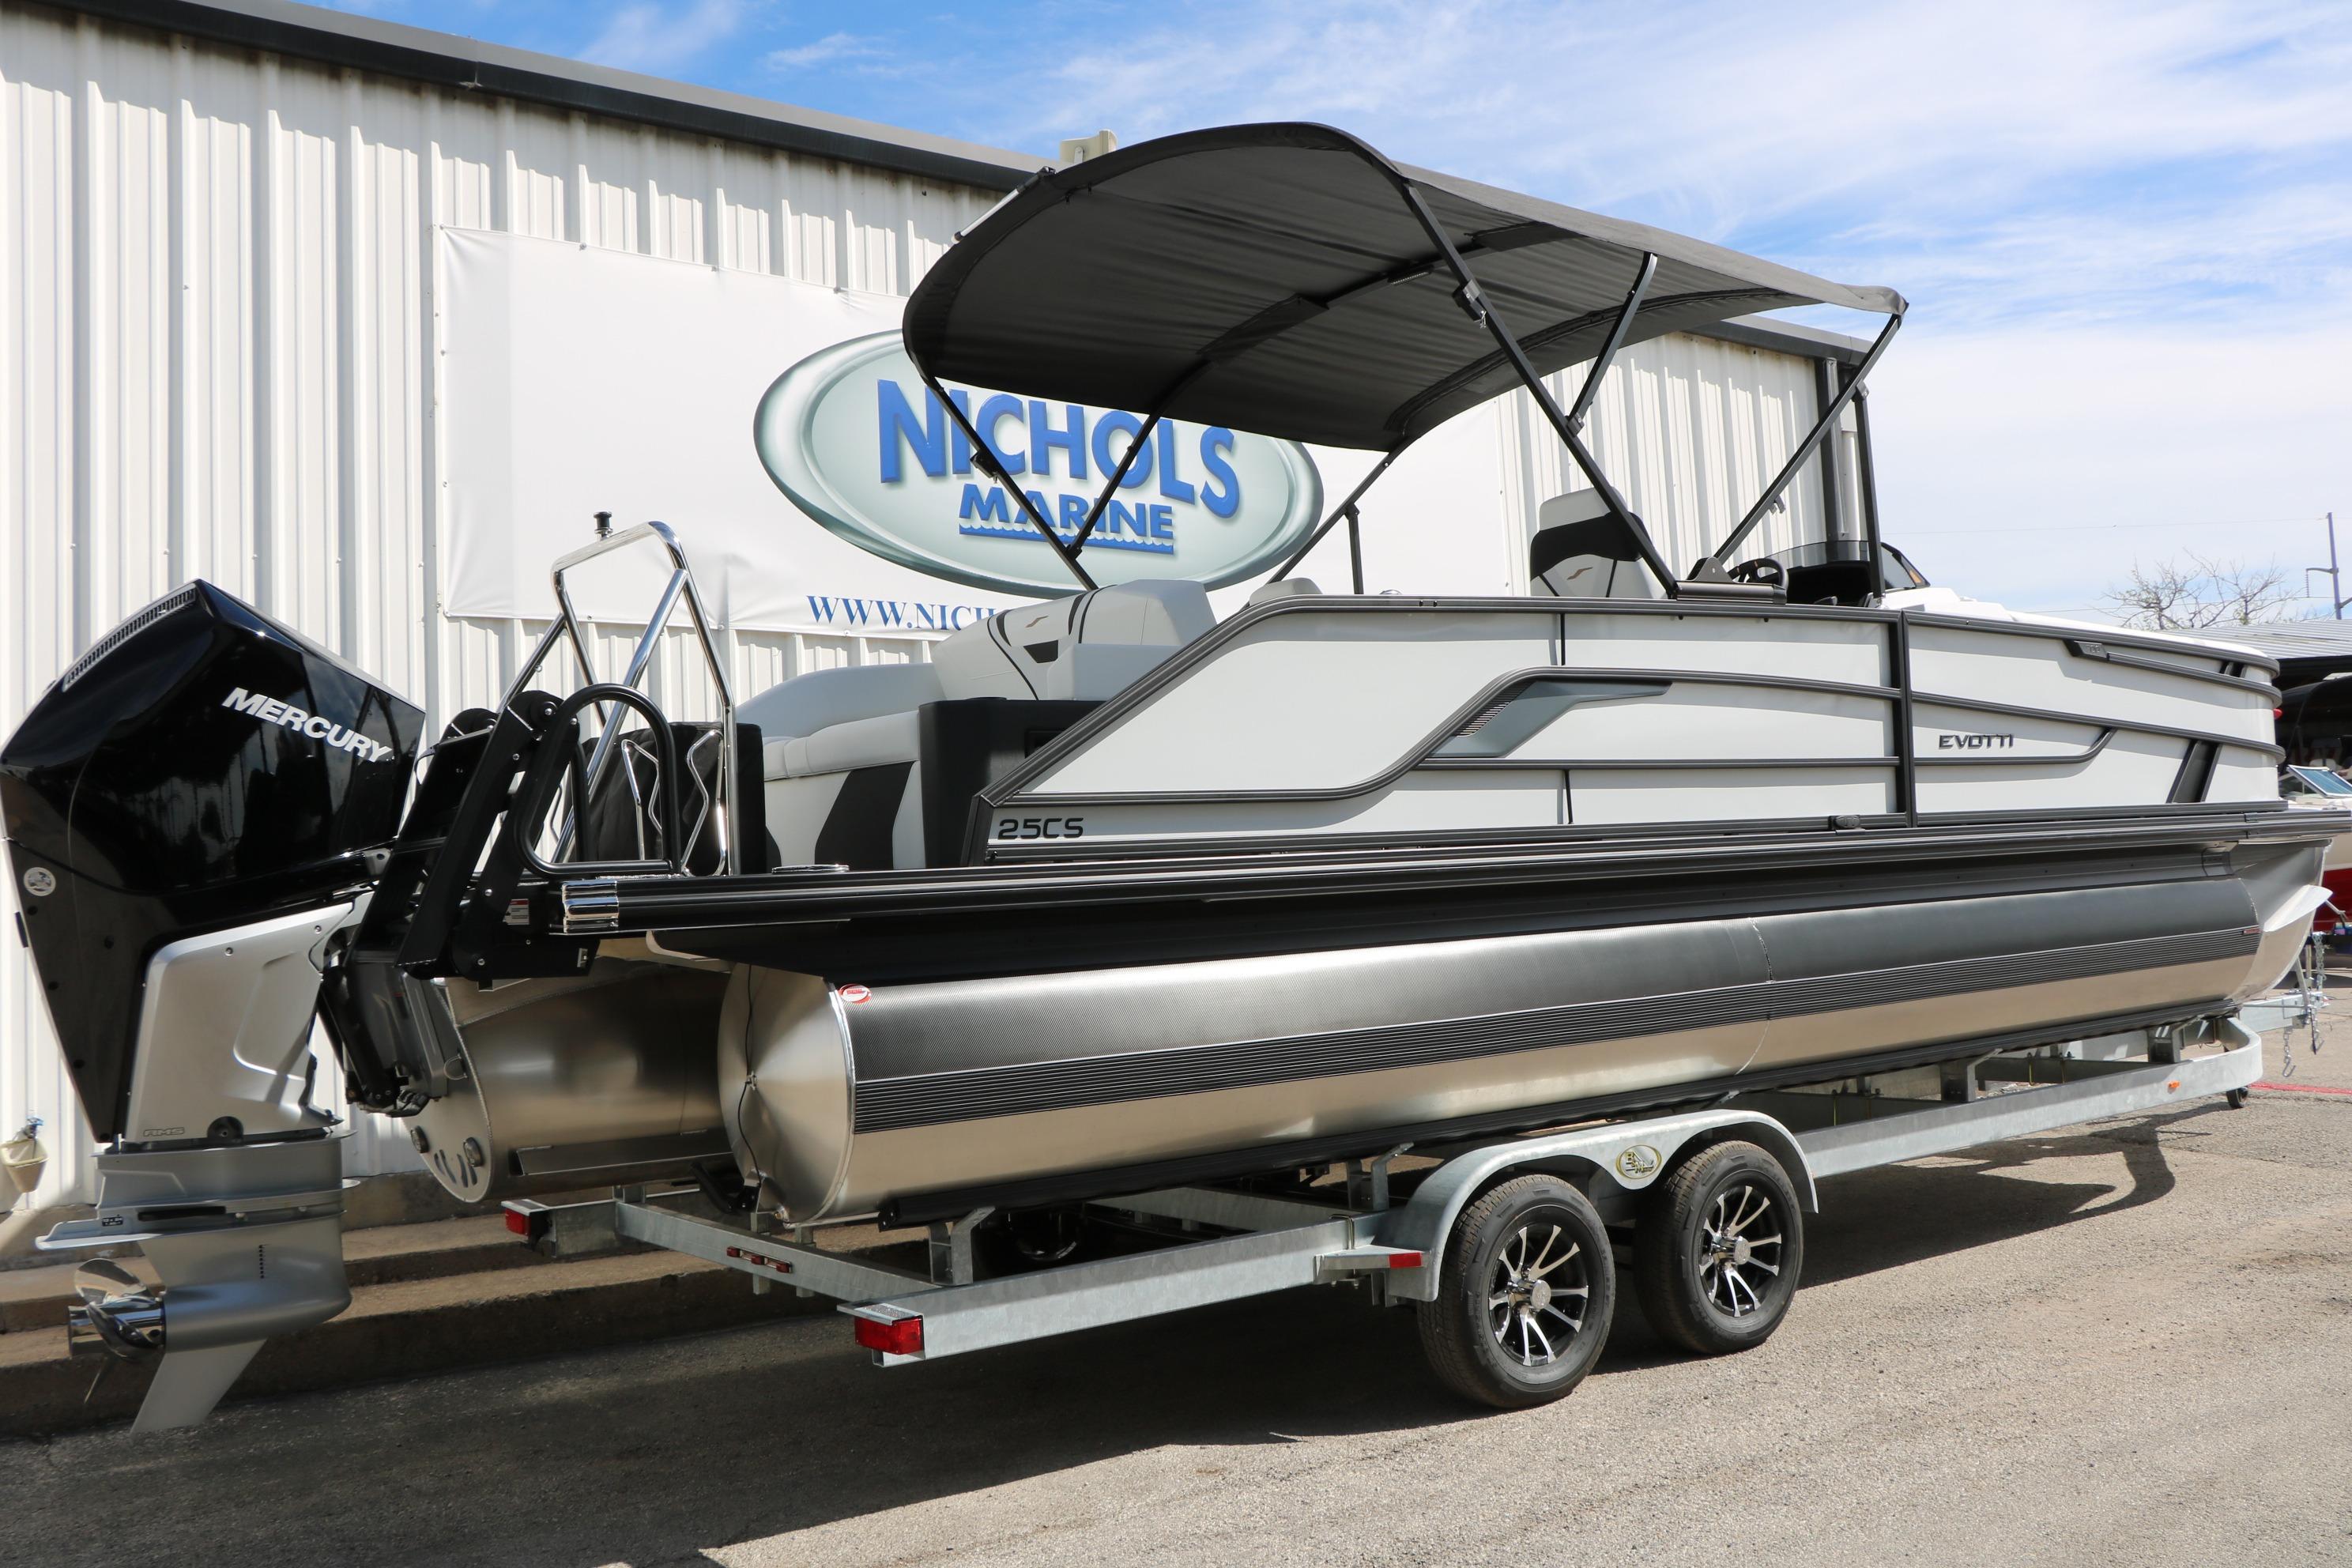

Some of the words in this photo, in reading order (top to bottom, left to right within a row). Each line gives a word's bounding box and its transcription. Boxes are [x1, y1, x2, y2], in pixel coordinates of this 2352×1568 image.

[876, 379, 1242, 518] NICHOLS
[959, 483, 1175, 540] MARINE
[221, 687, 392, 763] MERCURY
[1939, 734, 2014, 749] EVOTTI
[997, 818, 1084, 840] 25CS
